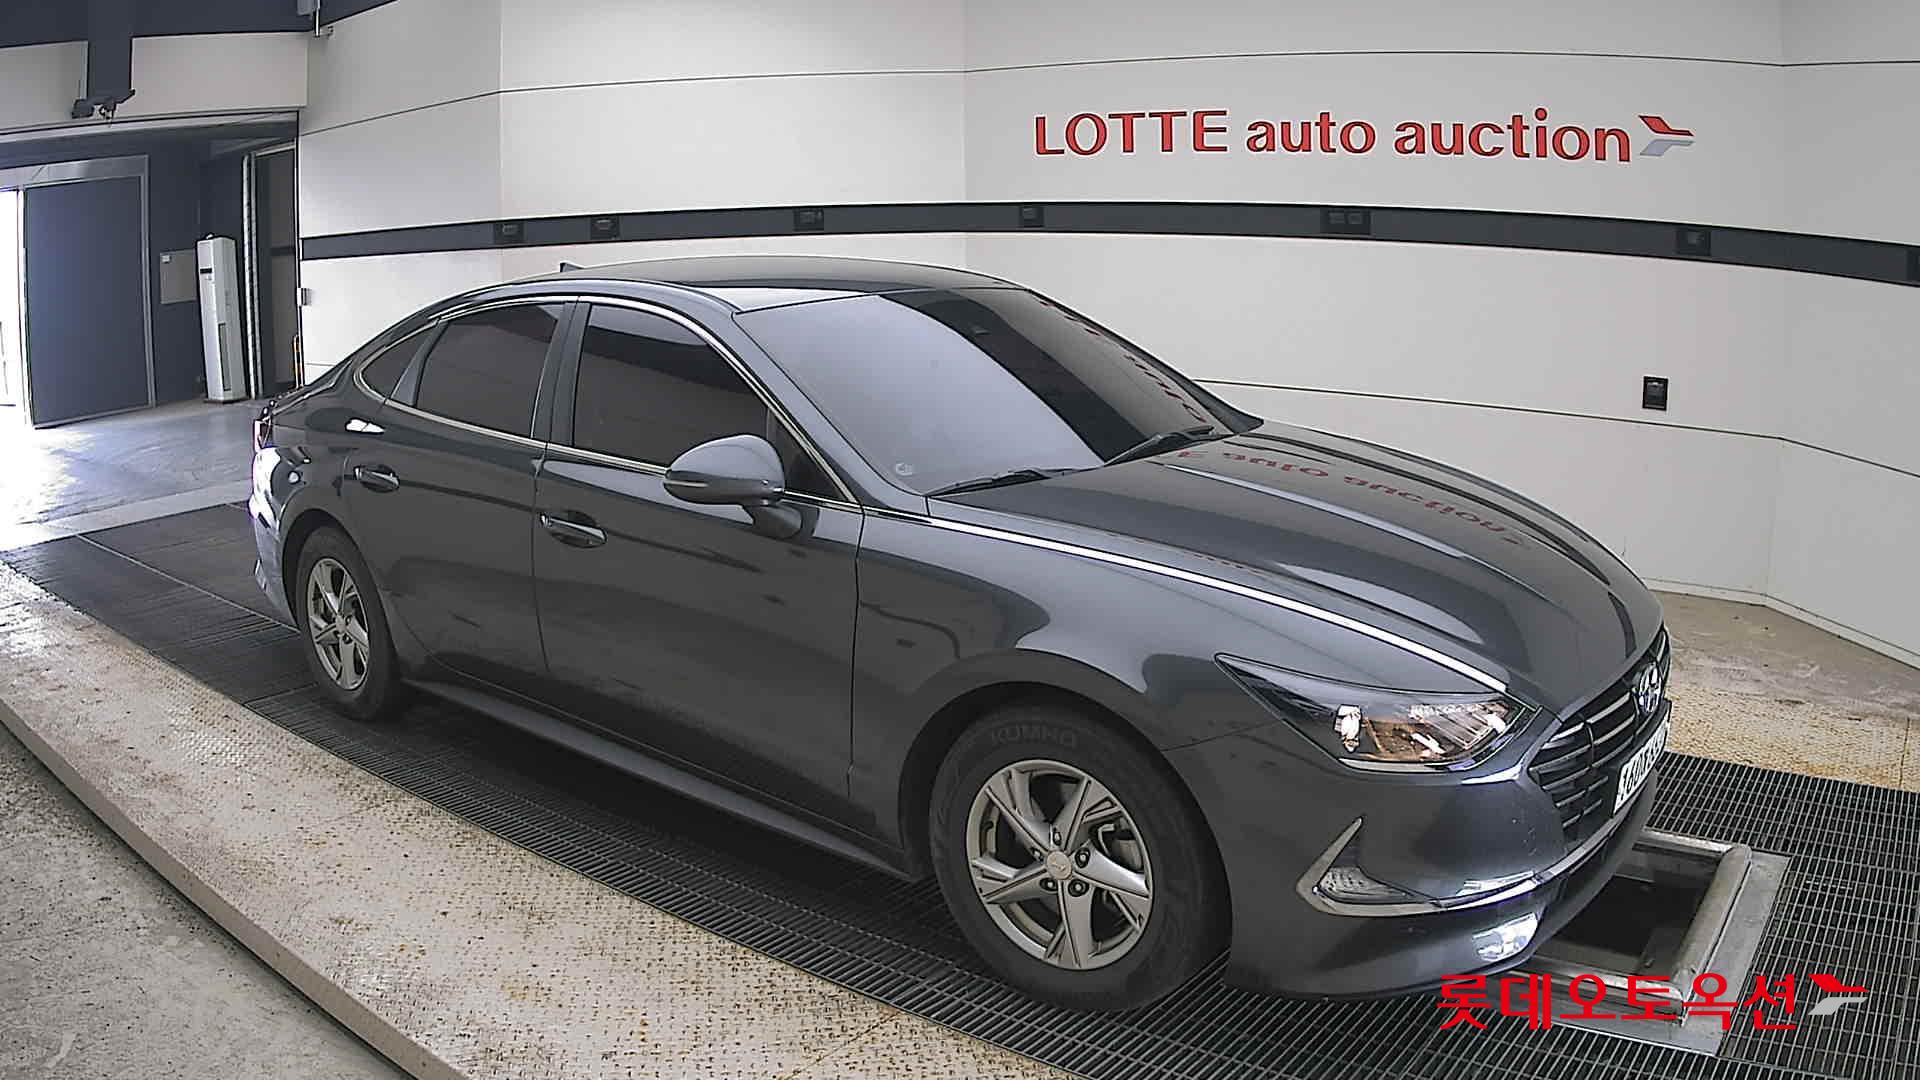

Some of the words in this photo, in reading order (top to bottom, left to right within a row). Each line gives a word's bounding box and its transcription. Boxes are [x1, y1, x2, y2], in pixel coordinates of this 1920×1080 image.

[1035, 110, 1228, 155] LOTTE
[1246, 111, 1376, 154] auto
[1394, 108, 1631, 163] auction
[990, 723, 1079, 750] KUMHO
